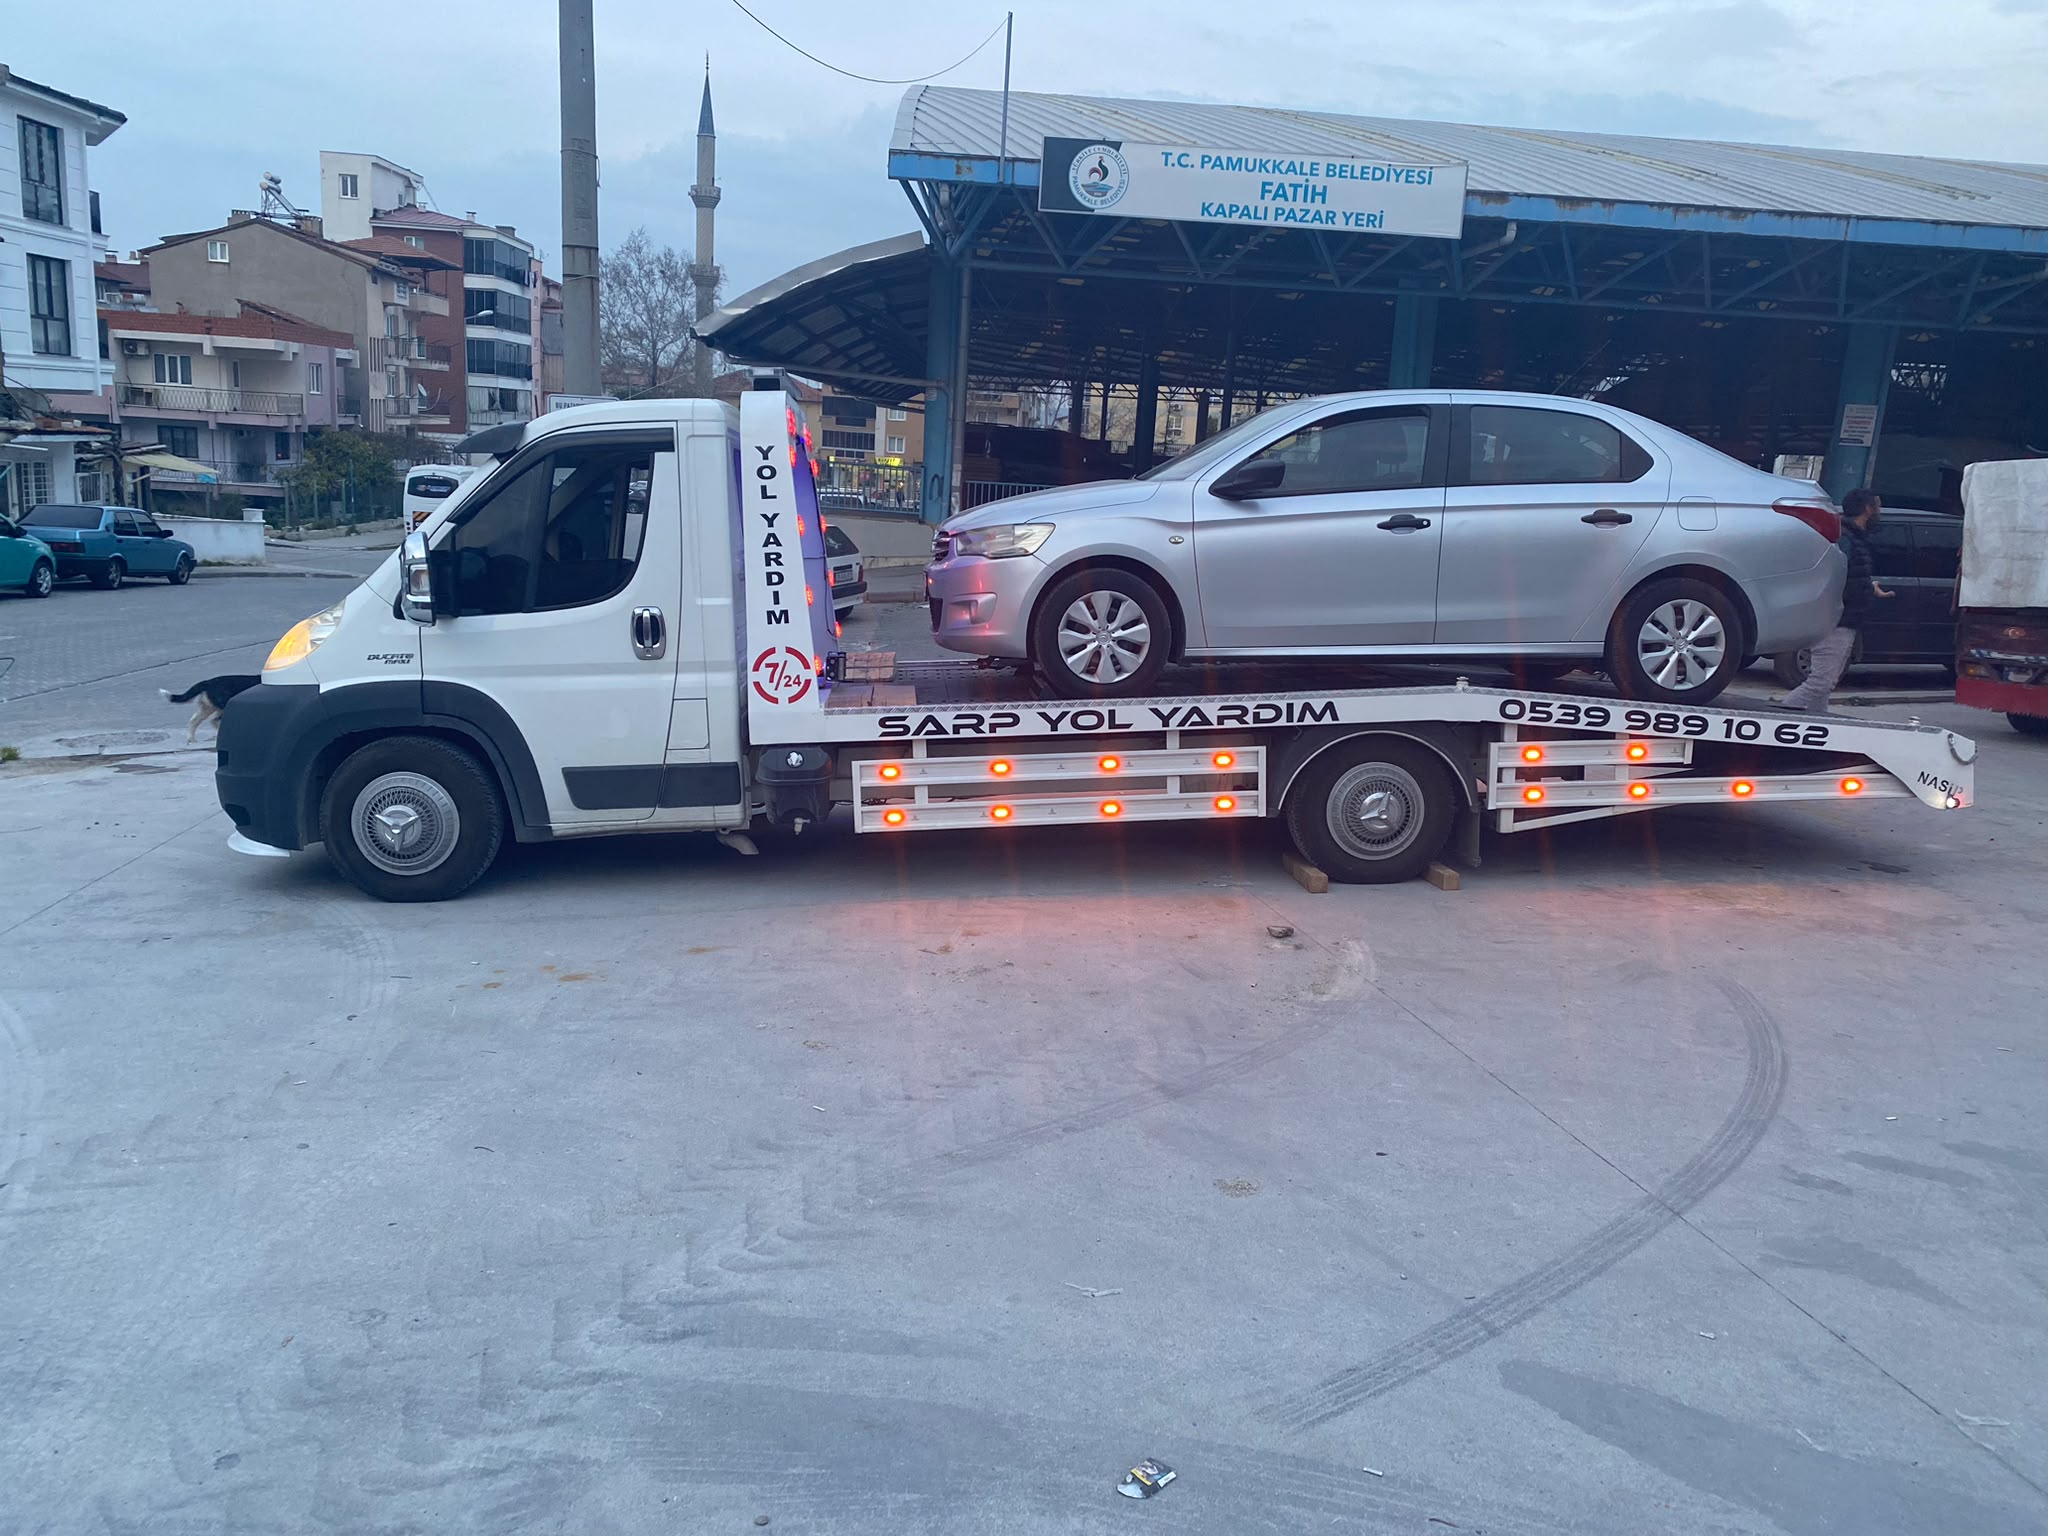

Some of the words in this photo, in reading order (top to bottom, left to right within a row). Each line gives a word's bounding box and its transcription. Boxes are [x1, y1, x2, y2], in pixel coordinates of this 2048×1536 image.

[1161, 151, 1195, 169] T.C.
[1200, 154, 1320, 177] PAMUKKALE
[1326, 162, 1434, 185] BELEDİYESİ
[1260, 179, 1328, 205] FATİH
[1200, 202, 1269, 220] KAPALI
[1274, 207, 1337, 225] PAZAR
[1342, 210, 1385, 229] YERİ
[754, 445, 777, 500] YOL
[760, 512, 790, 625] YARDIM
[764, 660, 802, 691] 7/24
[878, 711, 1021, 738] SARP
[1036, 709, 1134, 732] YOL
[1148, 701, 1340, 729] YARDIM
[1499, 698, 1611, 728] 0539
[1624, 710, 1709, 736] 989
[1722, 718, 1762, 742] 10
[1773, 723, 1831, 747] 62
